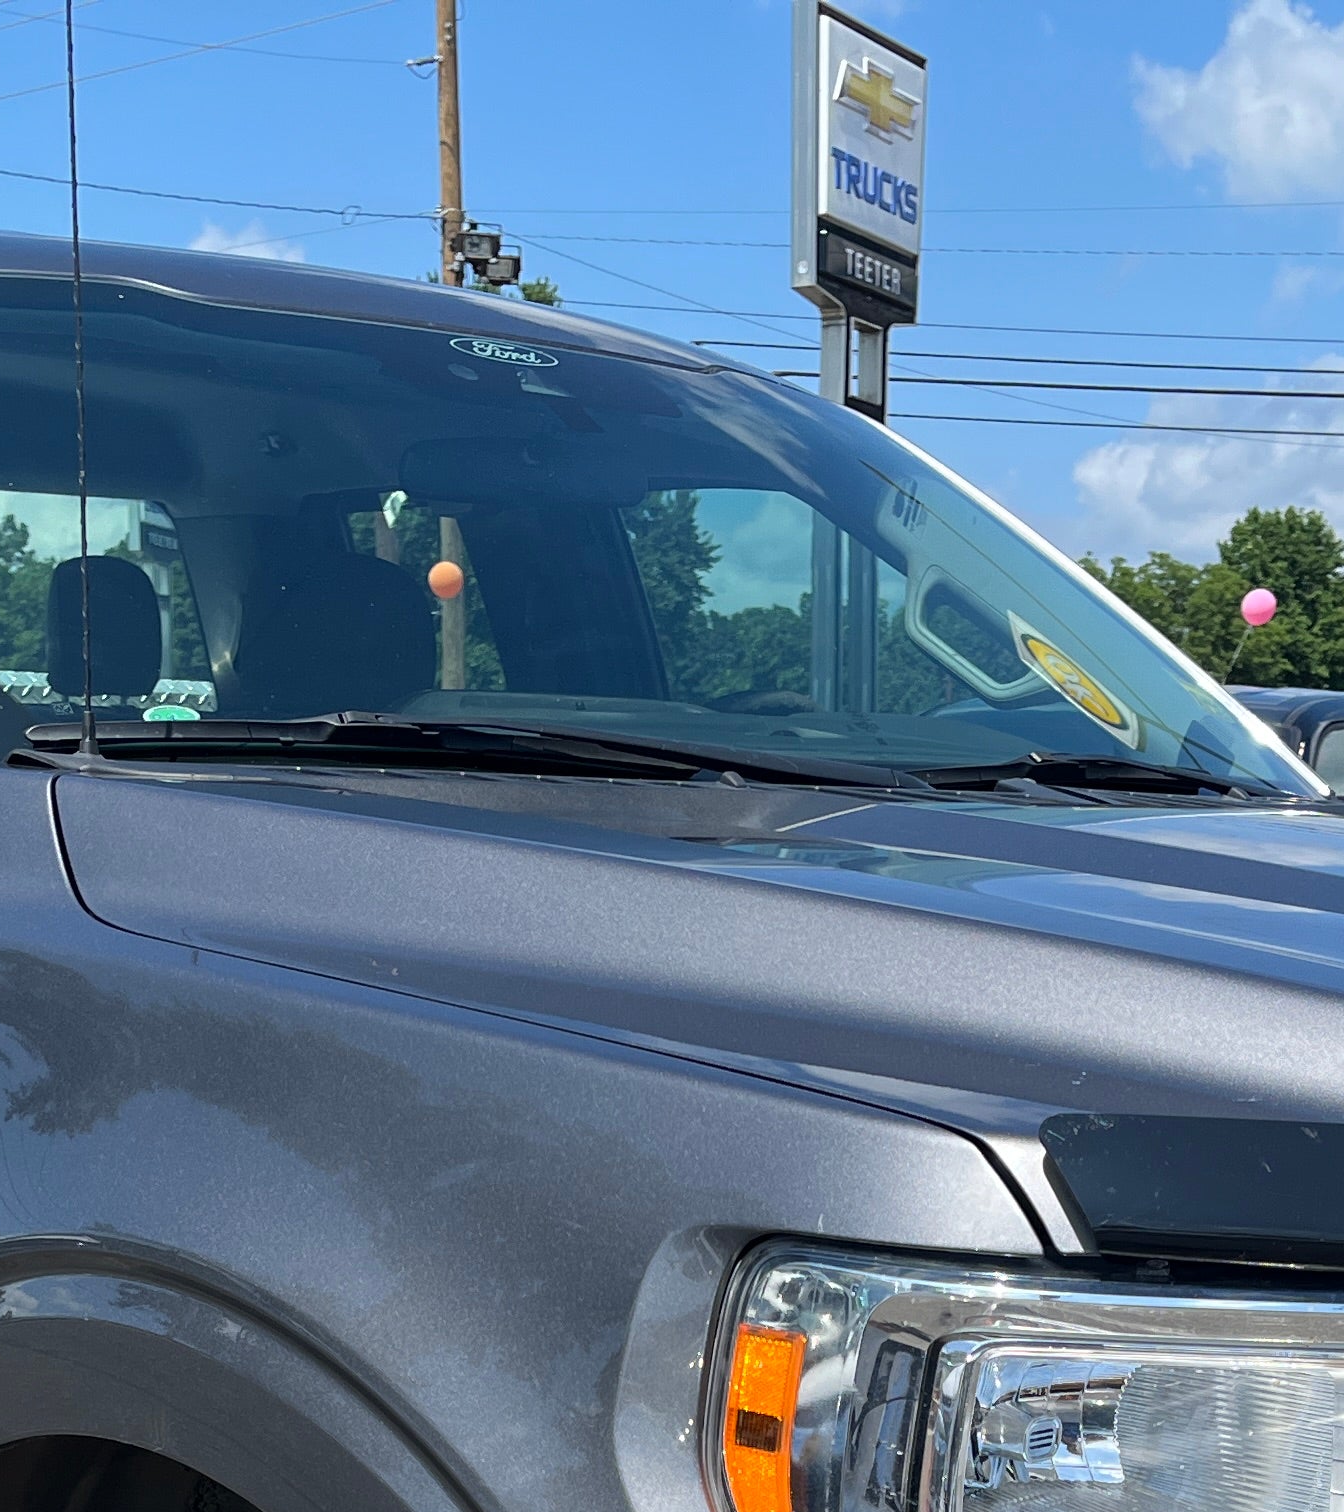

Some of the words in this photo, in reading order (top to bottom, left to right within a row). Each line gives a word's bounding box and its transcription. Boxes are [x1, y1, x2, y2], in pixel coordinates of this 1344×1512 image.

[831, 147, 918, 225] TRUCKS
[844, 247, 902, 296] TEETER
[472, 340, 542, 363] Ford
